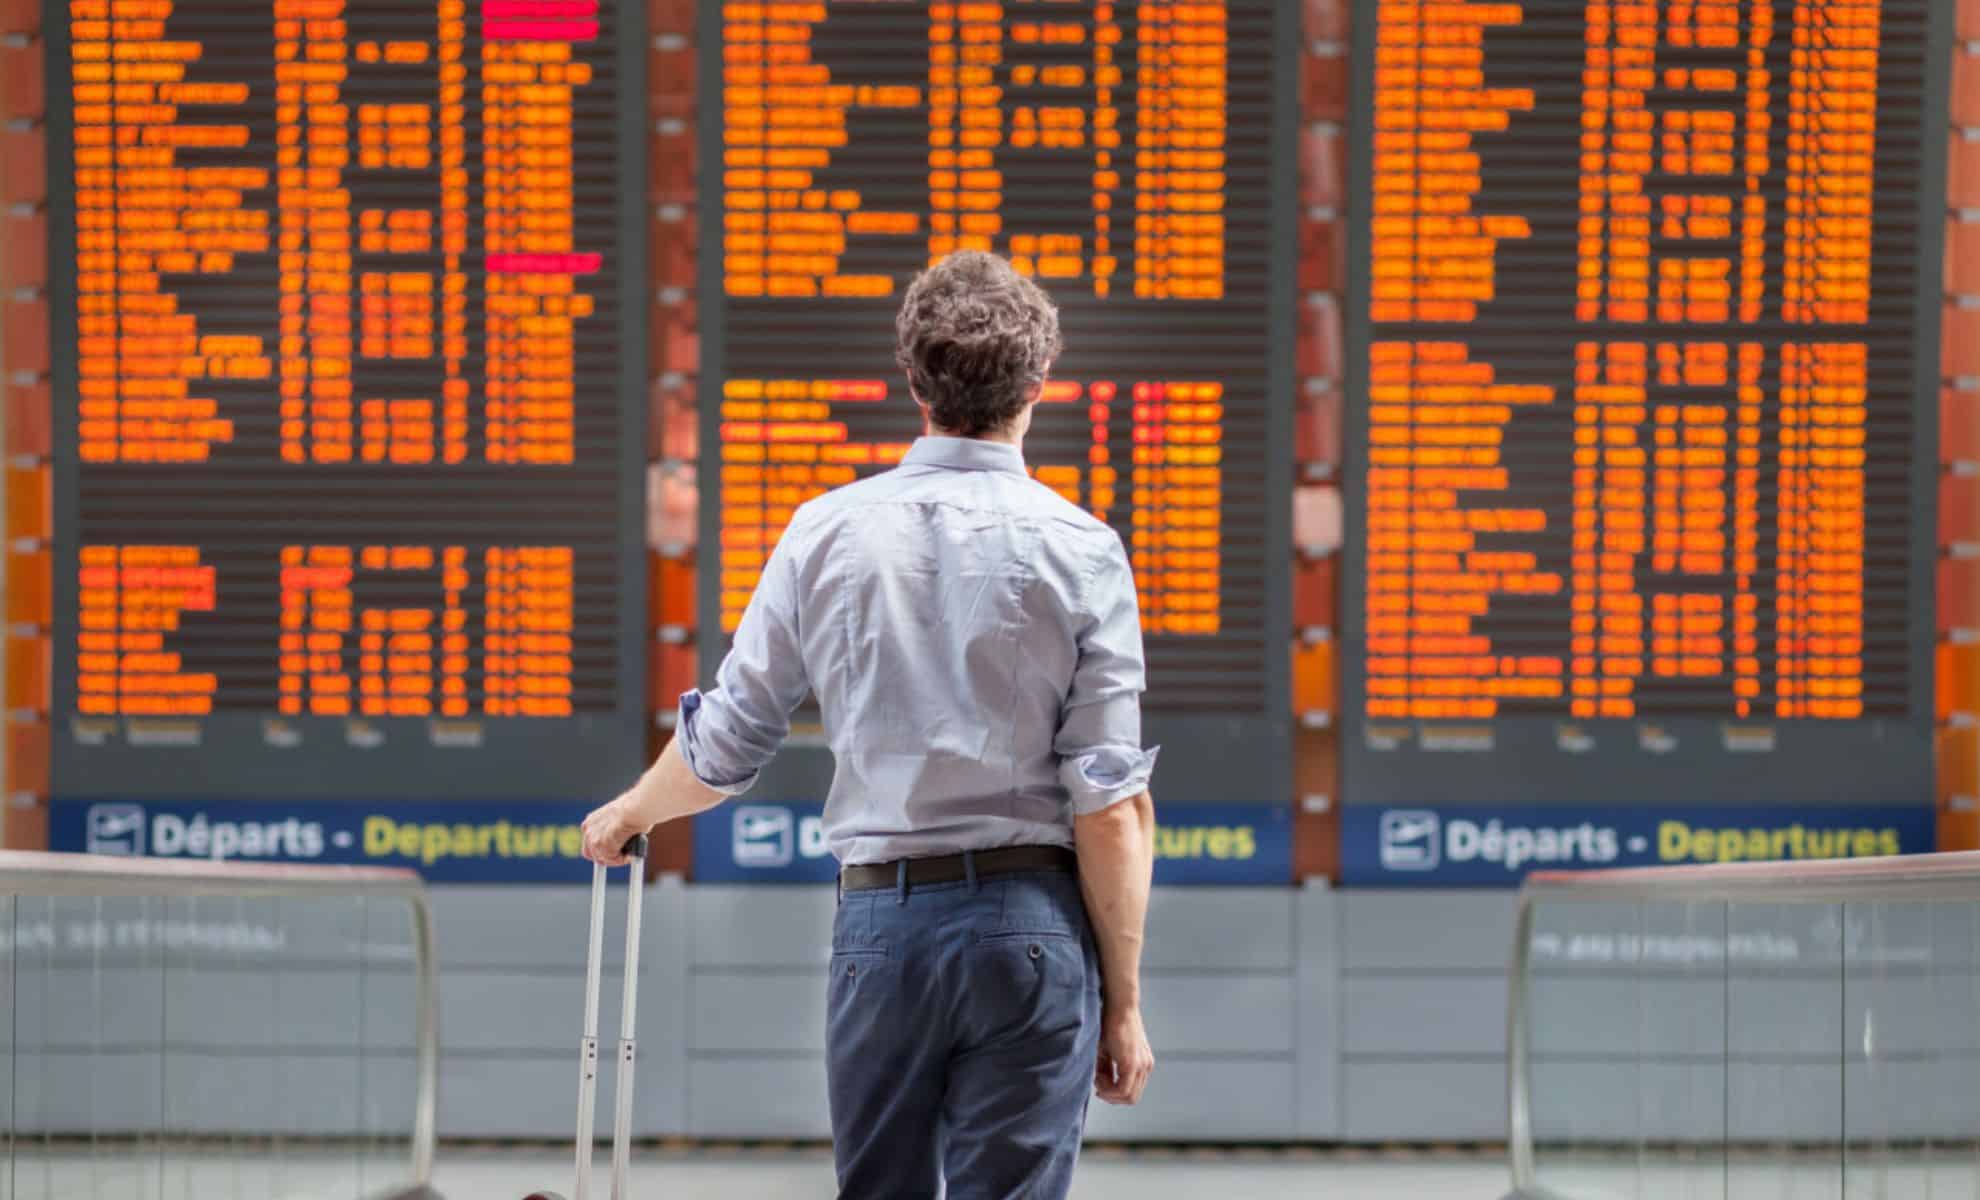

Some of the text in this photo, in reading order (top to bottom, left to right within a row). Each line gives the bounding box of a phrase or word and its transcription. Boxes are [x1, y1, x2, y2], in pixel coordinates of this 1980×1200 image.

[153, 811, 323, 861] Départs
[364, 815, 582, 865] Departure
[1447, 818, 1619, 871] Départs
[1658, 819, 1901, 864] Departures
